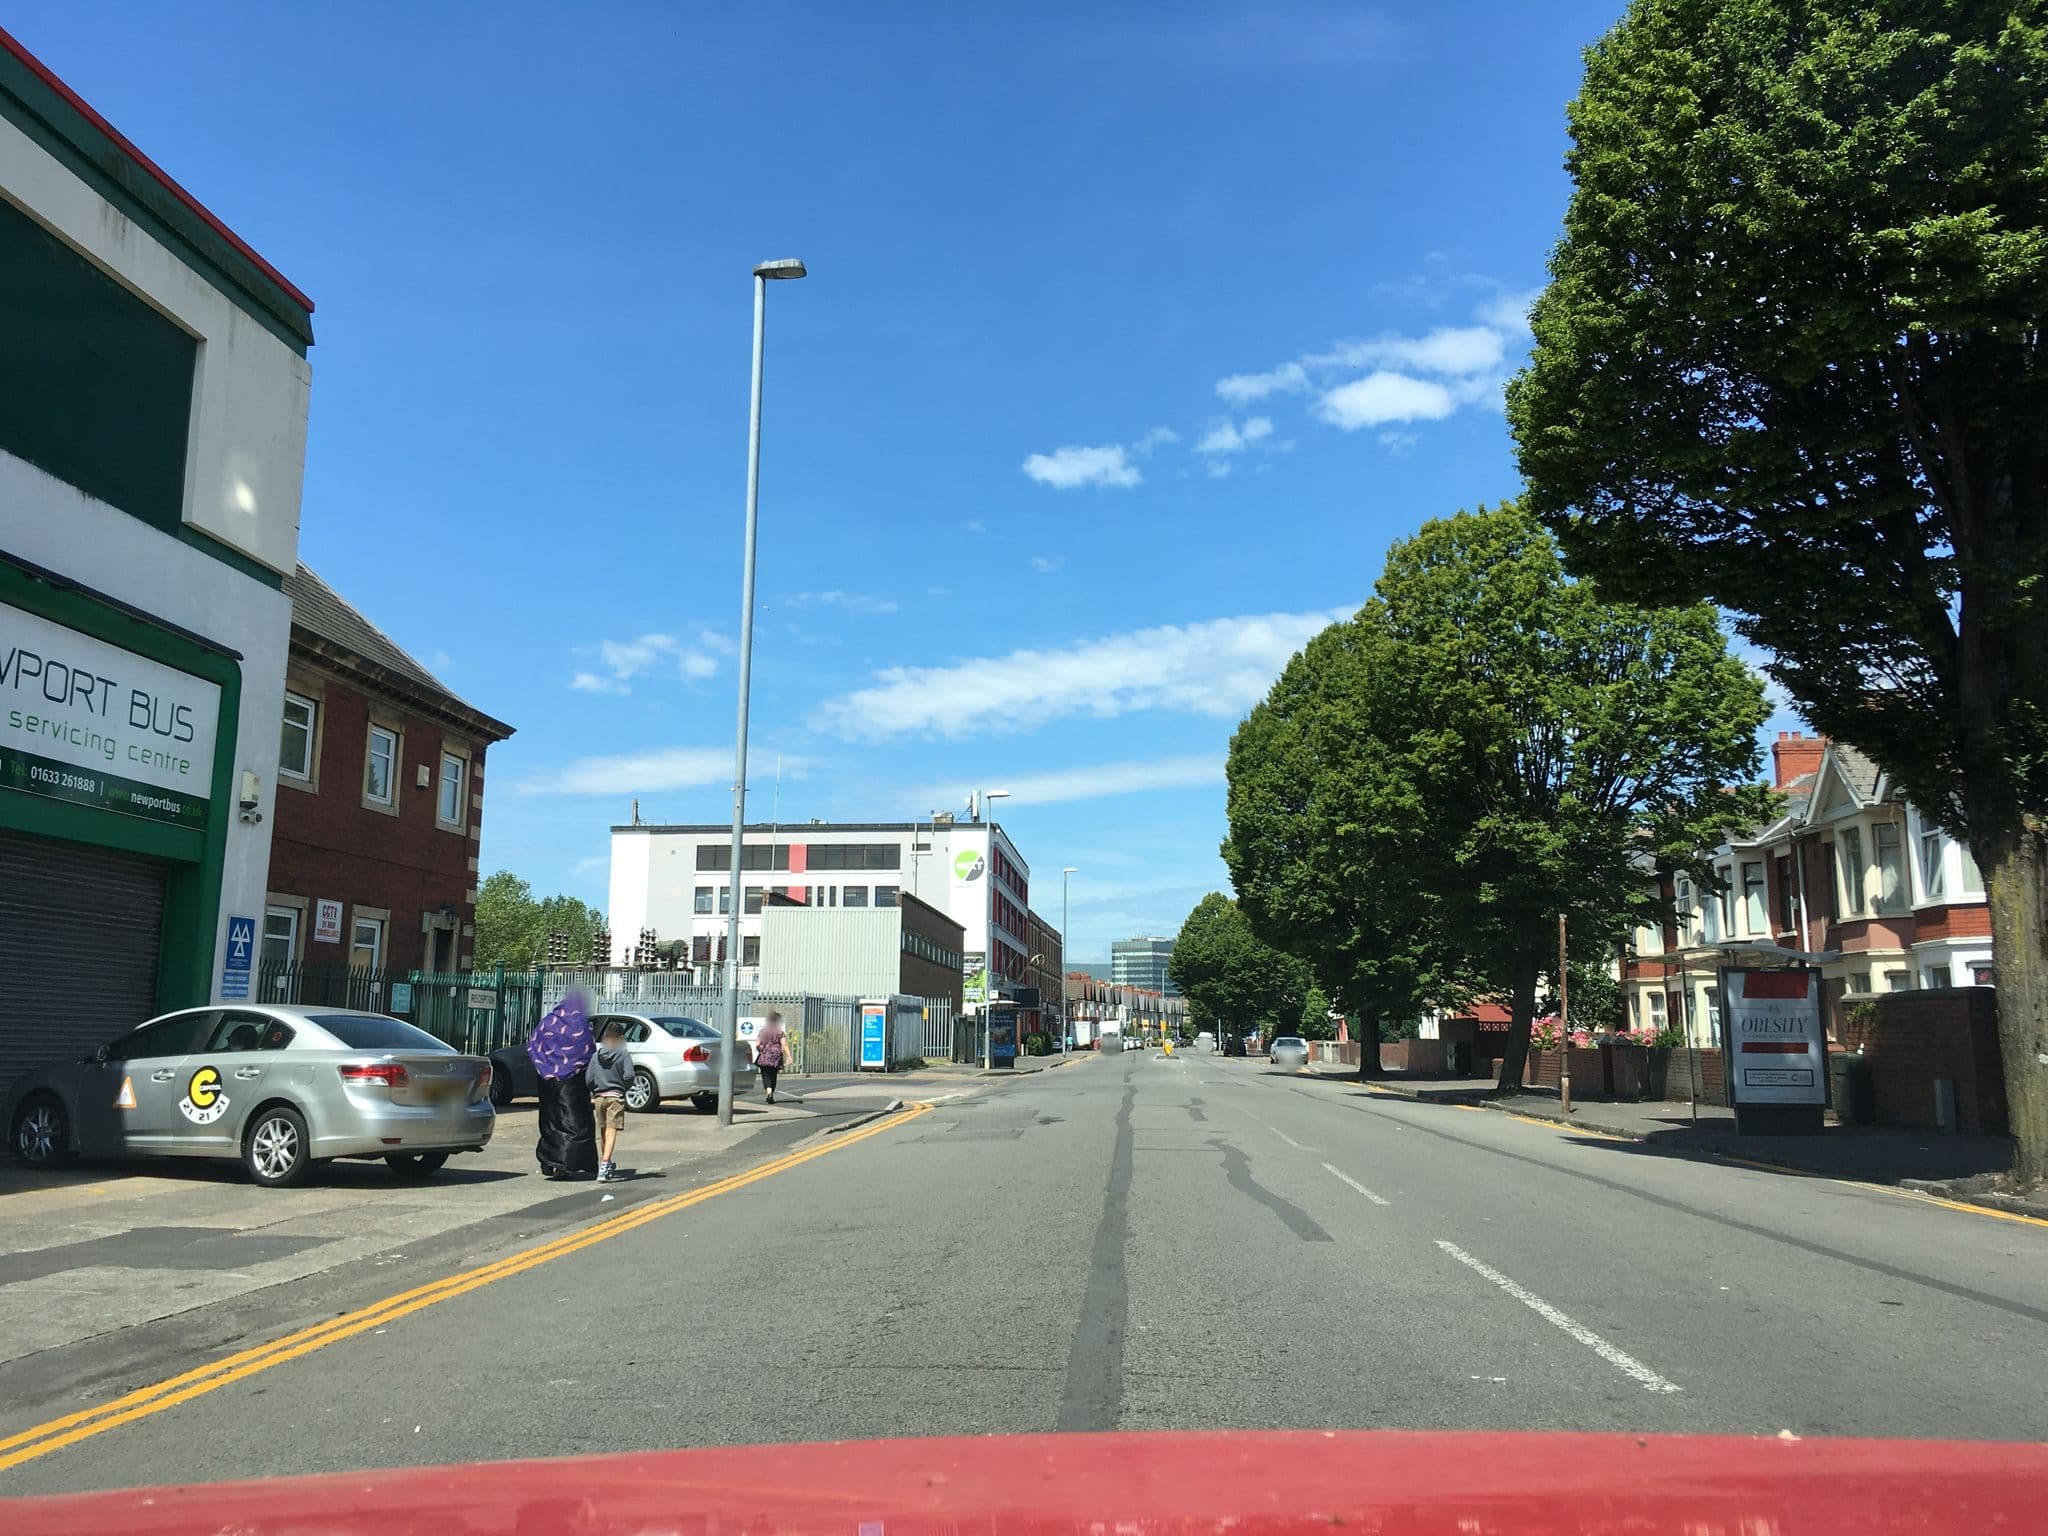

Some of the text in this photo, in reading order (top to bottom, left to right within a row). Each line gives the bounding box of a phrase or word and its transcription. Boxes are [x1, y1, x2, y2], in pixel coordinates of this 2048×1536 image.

[129, 689, 194, 743] BUS
[9, 710, 190, 775] servicing centre
[31, 766, 60, 784] 01633
[62, 773, 95, 793] 261888
[1741, 1016, 1808, 1034] OBESITY
[183, 1099, 226, 1121] 21 21 21
